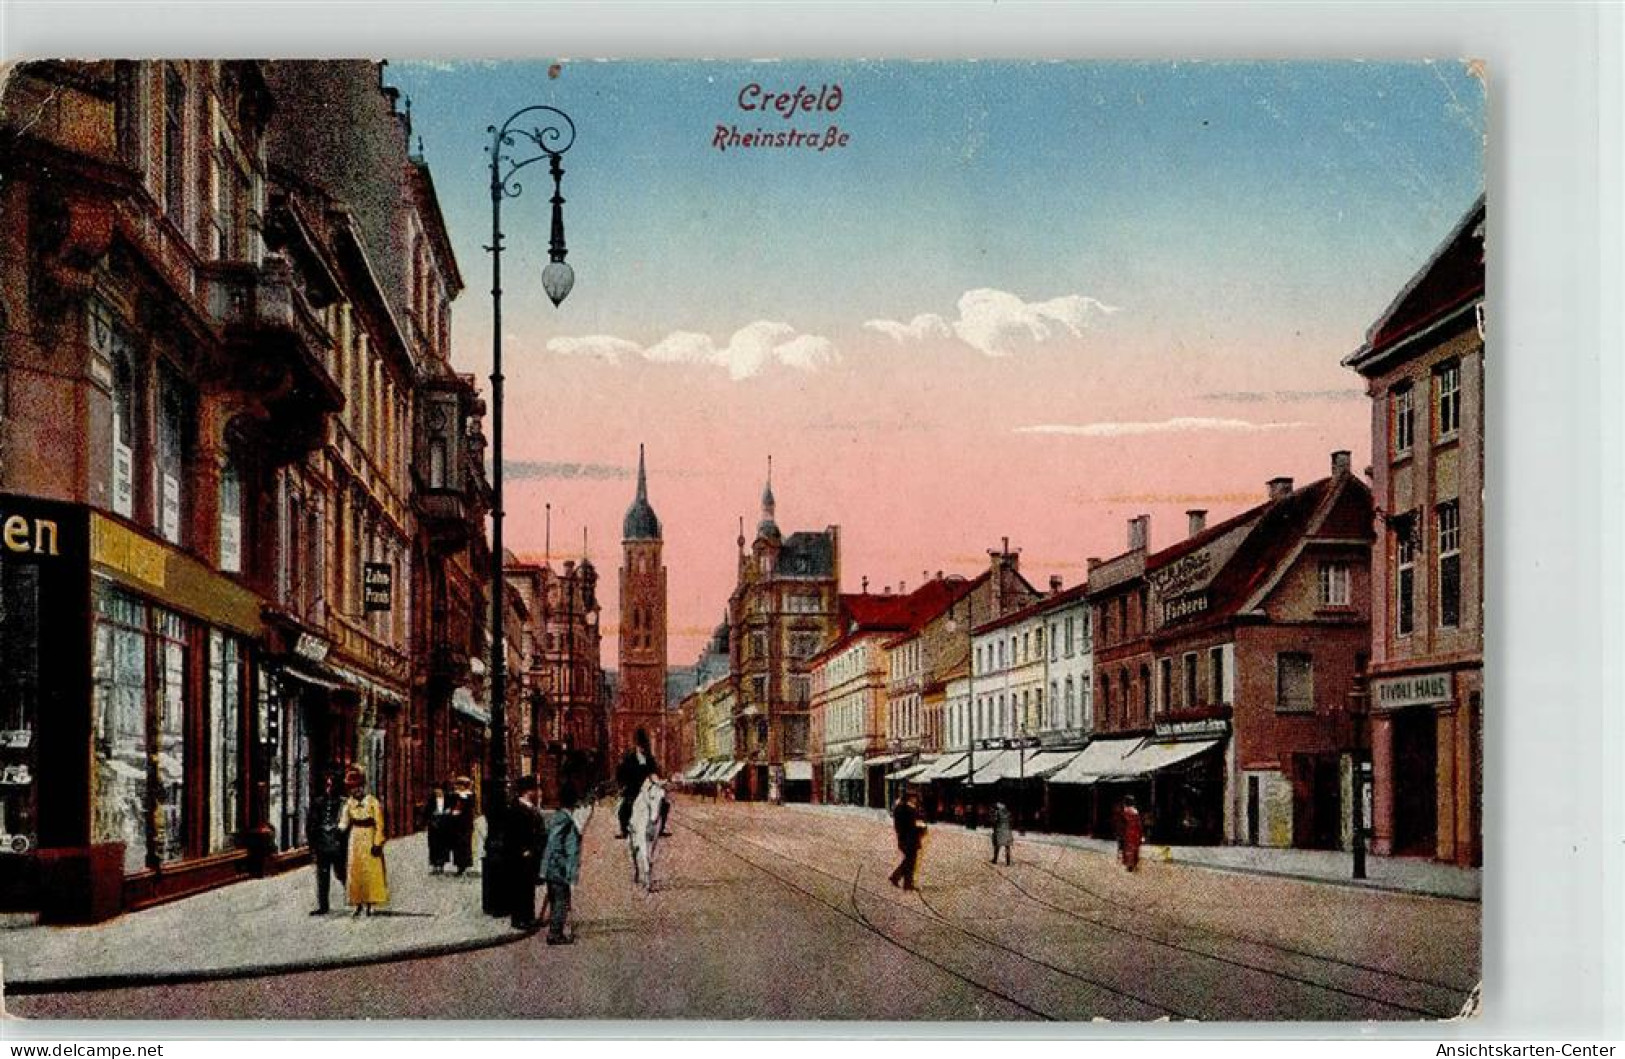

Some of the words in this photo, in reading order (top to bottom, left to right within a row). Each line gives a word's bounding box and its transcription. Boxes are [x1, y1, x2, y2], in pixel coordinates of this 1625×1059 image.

[738, 82, 843, 119] Crefeld
[712, 124, 850, 152] Rheinstraße
[1415, 677, 1446, 698] HAUS
